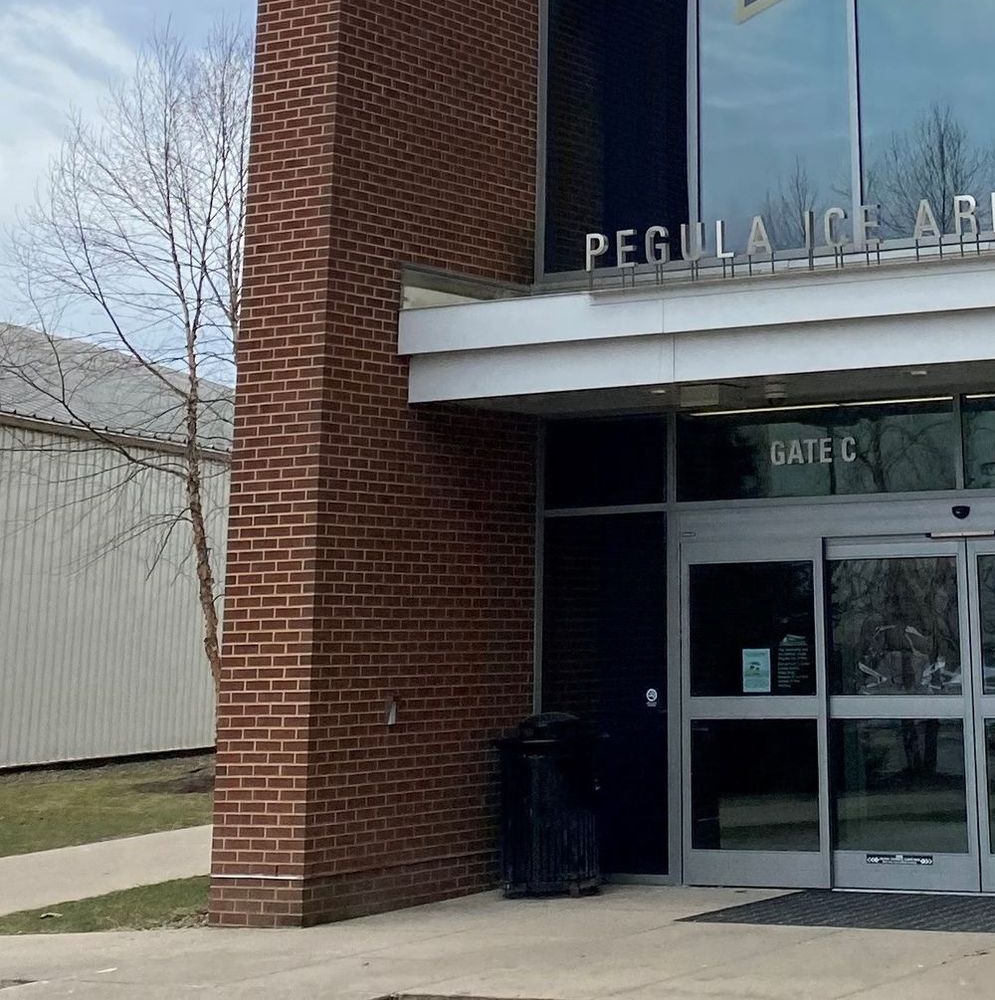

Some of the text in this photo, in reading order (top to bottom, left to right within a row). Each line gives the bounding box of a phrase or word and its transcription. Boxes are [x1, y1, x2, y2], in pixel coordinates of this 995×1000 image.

[584, 215, 774, 272] PEGULA
[804, 204, 881, 249] ICE
[770, 436, 857, 466] GATE C
